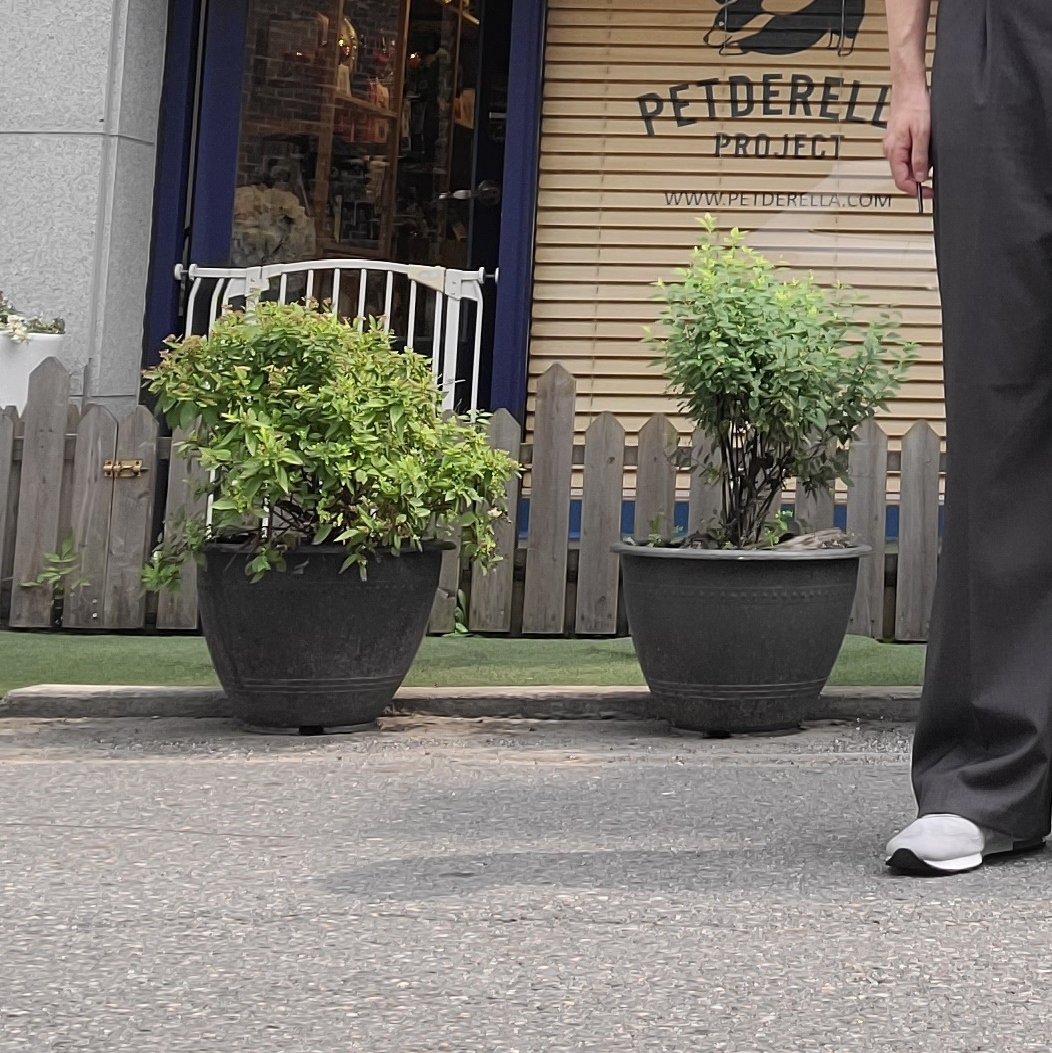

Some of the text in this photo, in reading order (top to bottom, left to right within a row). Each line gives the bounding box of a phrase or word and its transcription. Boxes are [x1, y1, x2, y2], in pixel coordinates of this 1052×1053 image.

[636, 74, 890, 138] PETDERELL
[714, 132, 845, 160] PROJECT
[664, 191, 892, 208] WWW.PETDERELLA.COM
